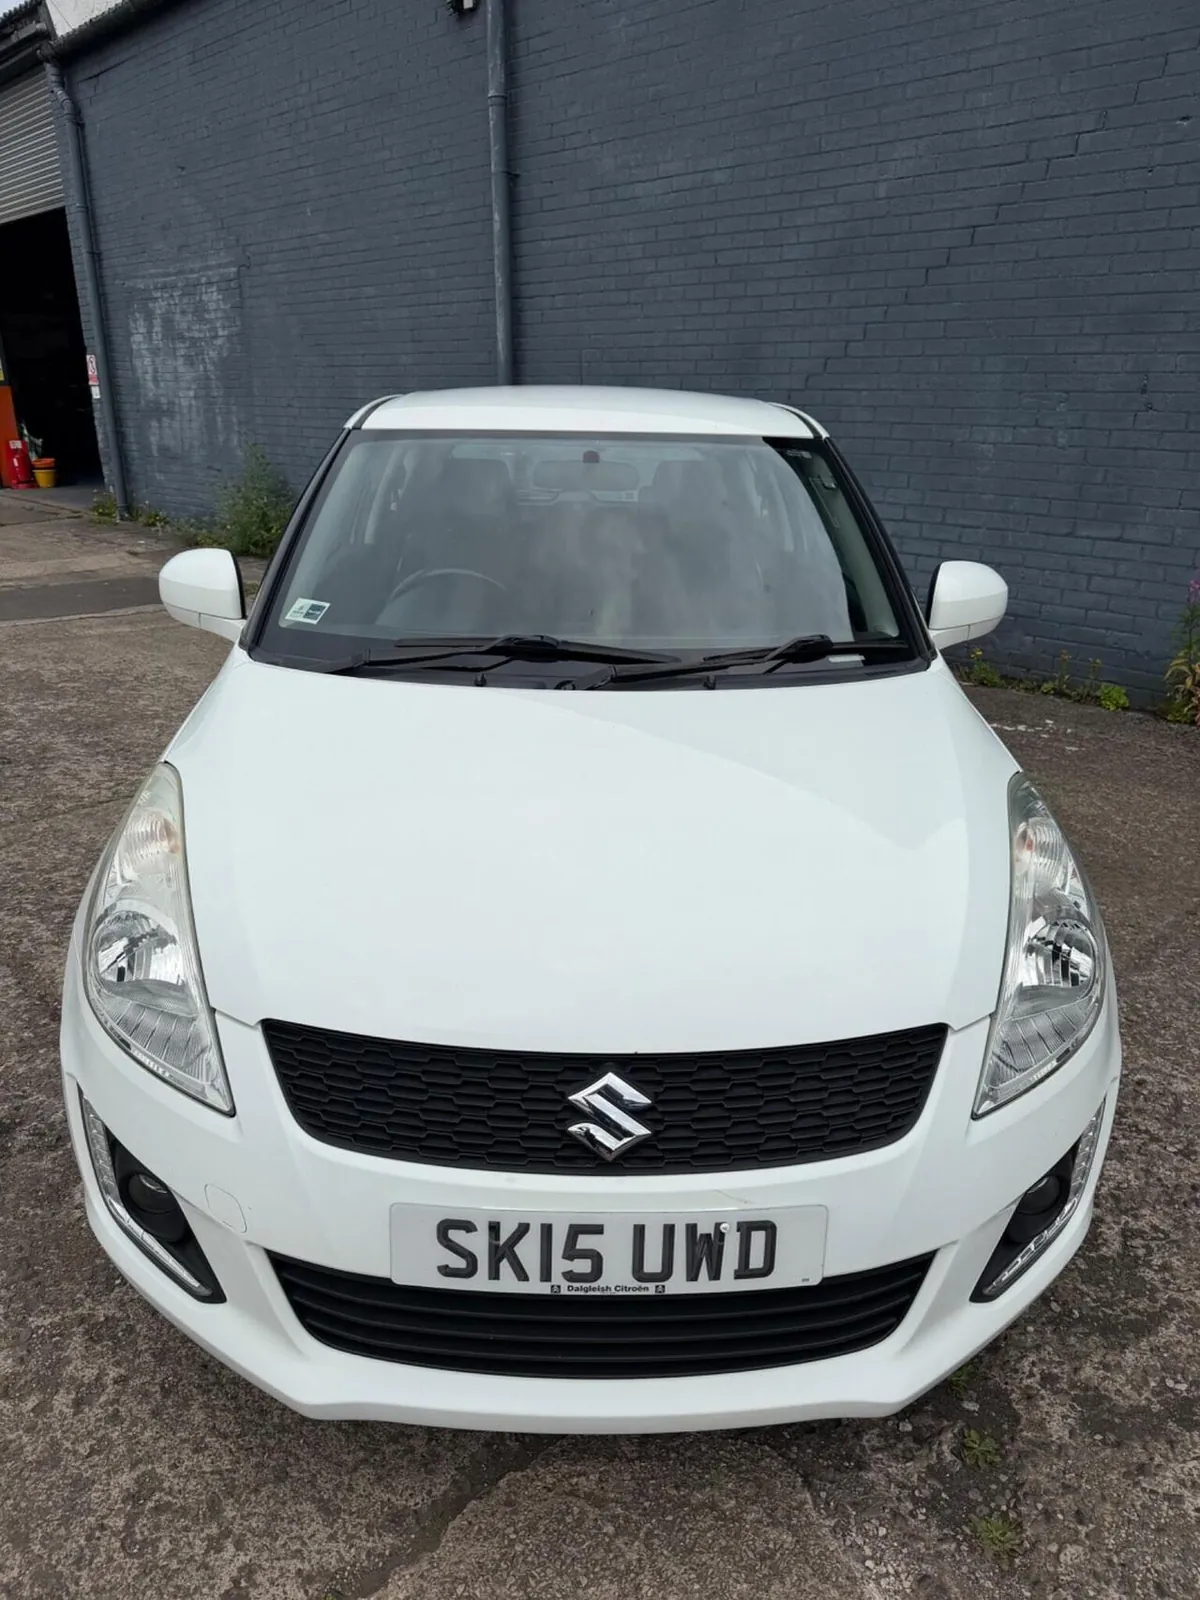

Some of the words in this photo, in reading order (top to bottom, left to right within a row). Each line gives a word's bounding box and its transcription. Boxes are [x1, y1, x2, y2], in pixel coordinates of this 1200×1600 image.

[436, 1218, 605, 1283] SK15
[632, 1220, 778, 1283] UWD
[566, 1284, 612, 1294] Dalgleish
